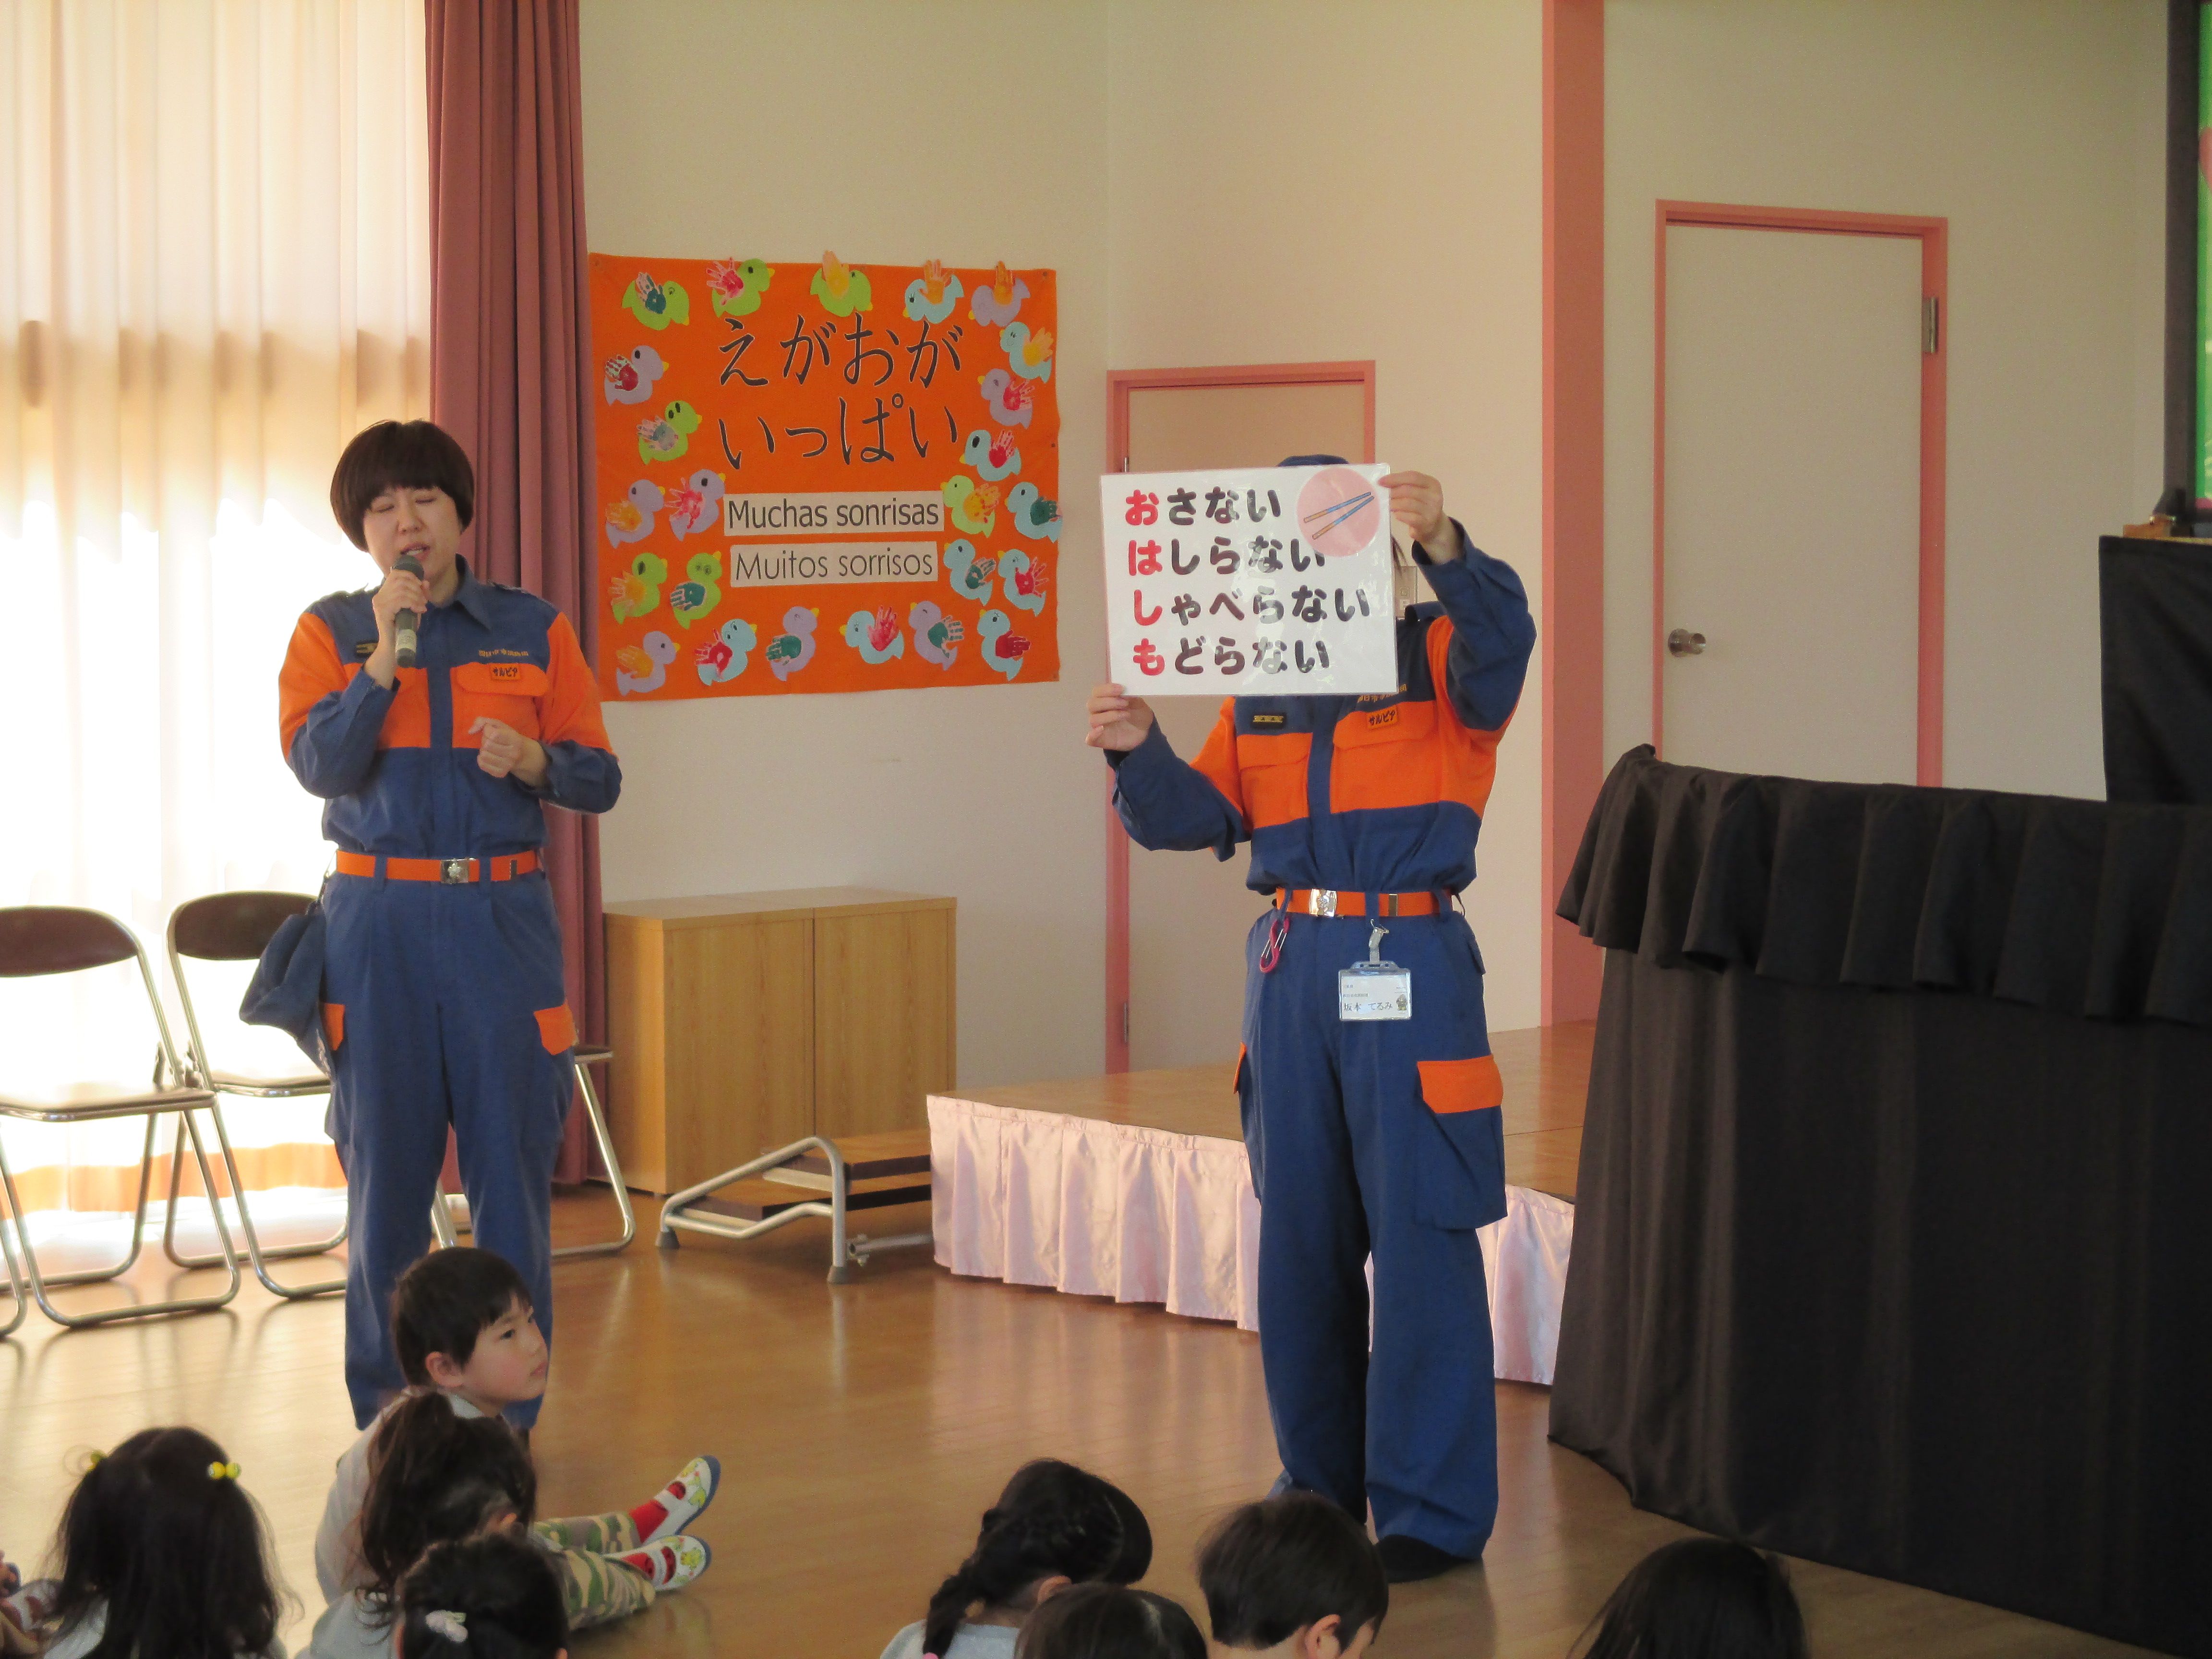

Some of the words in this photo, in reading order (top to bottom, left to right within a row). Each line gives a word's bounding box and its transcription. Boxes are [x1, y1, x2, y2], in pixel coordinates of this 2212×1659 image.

[718, 313, 963, 389] えがおが
[718, 393, 958, 470] いっぱい
[728, 498, 828, 529] Muchas
[836, 497, 939, 526] sonrisas
[1125, 486, 1281, 526] おさない
[735, 551, 829, 581] Muitos
[838, 547, 933, 577] sorrisos
[1128, 535, 1326, 576] はしらない
[1133, 584, 1370, 626] しゃべらない
[1132, 635, 1330, 676] もどらない
[1369, 709, 1396, 726] サルビア
